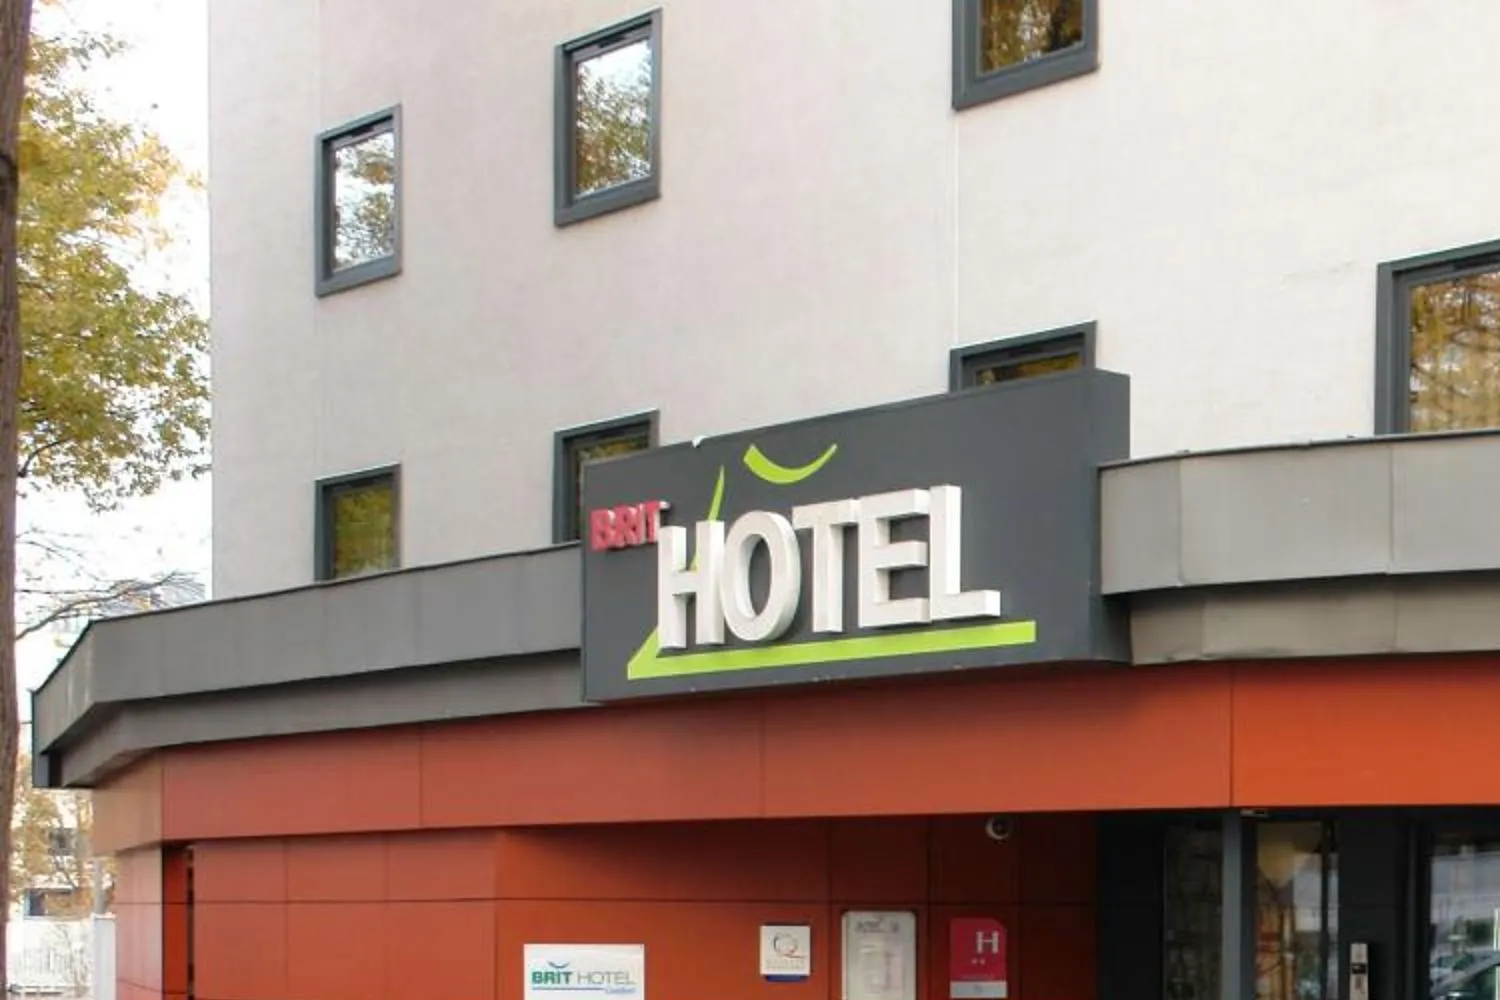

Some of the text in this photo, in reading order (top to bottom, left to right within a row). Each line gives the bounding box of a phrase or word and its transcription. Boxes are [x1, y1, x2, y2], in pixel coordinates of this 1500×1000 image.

[591, 501, 668, 552] BRIT
[657, 485, 1001, 650] HOTEL
[976, 930, 999, 954] H
[532, 971, 637, 985] BRIT HOTEL
